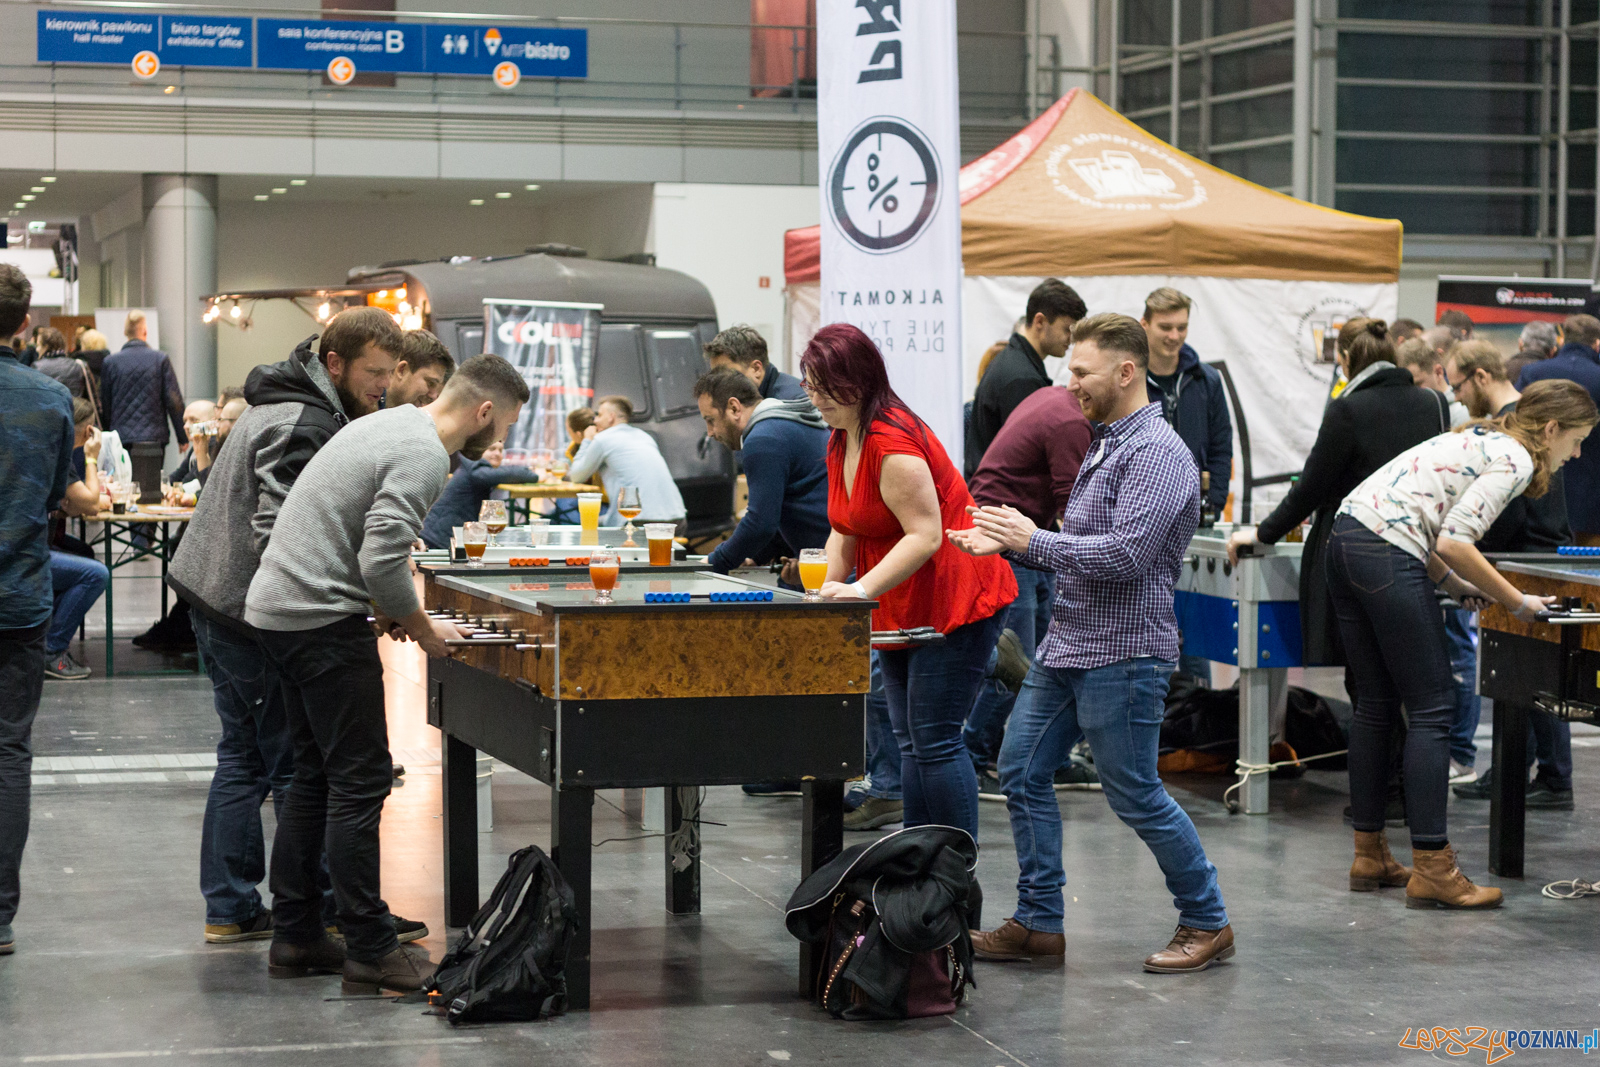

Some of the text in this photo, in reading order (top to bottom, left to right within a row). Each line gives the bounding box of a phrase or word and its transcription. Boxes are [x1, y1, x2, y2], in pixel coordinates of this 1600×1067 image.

[46, 18, 152, 34] kierownik pawilonu
[171, 22, 241, 39] biuro targów
[73, 33, 124, 45] hall master
[303, 27, 384, 43] konferencyjna
[385, 30, 405, 53] B
[305, 41, 383, 53] conference room
